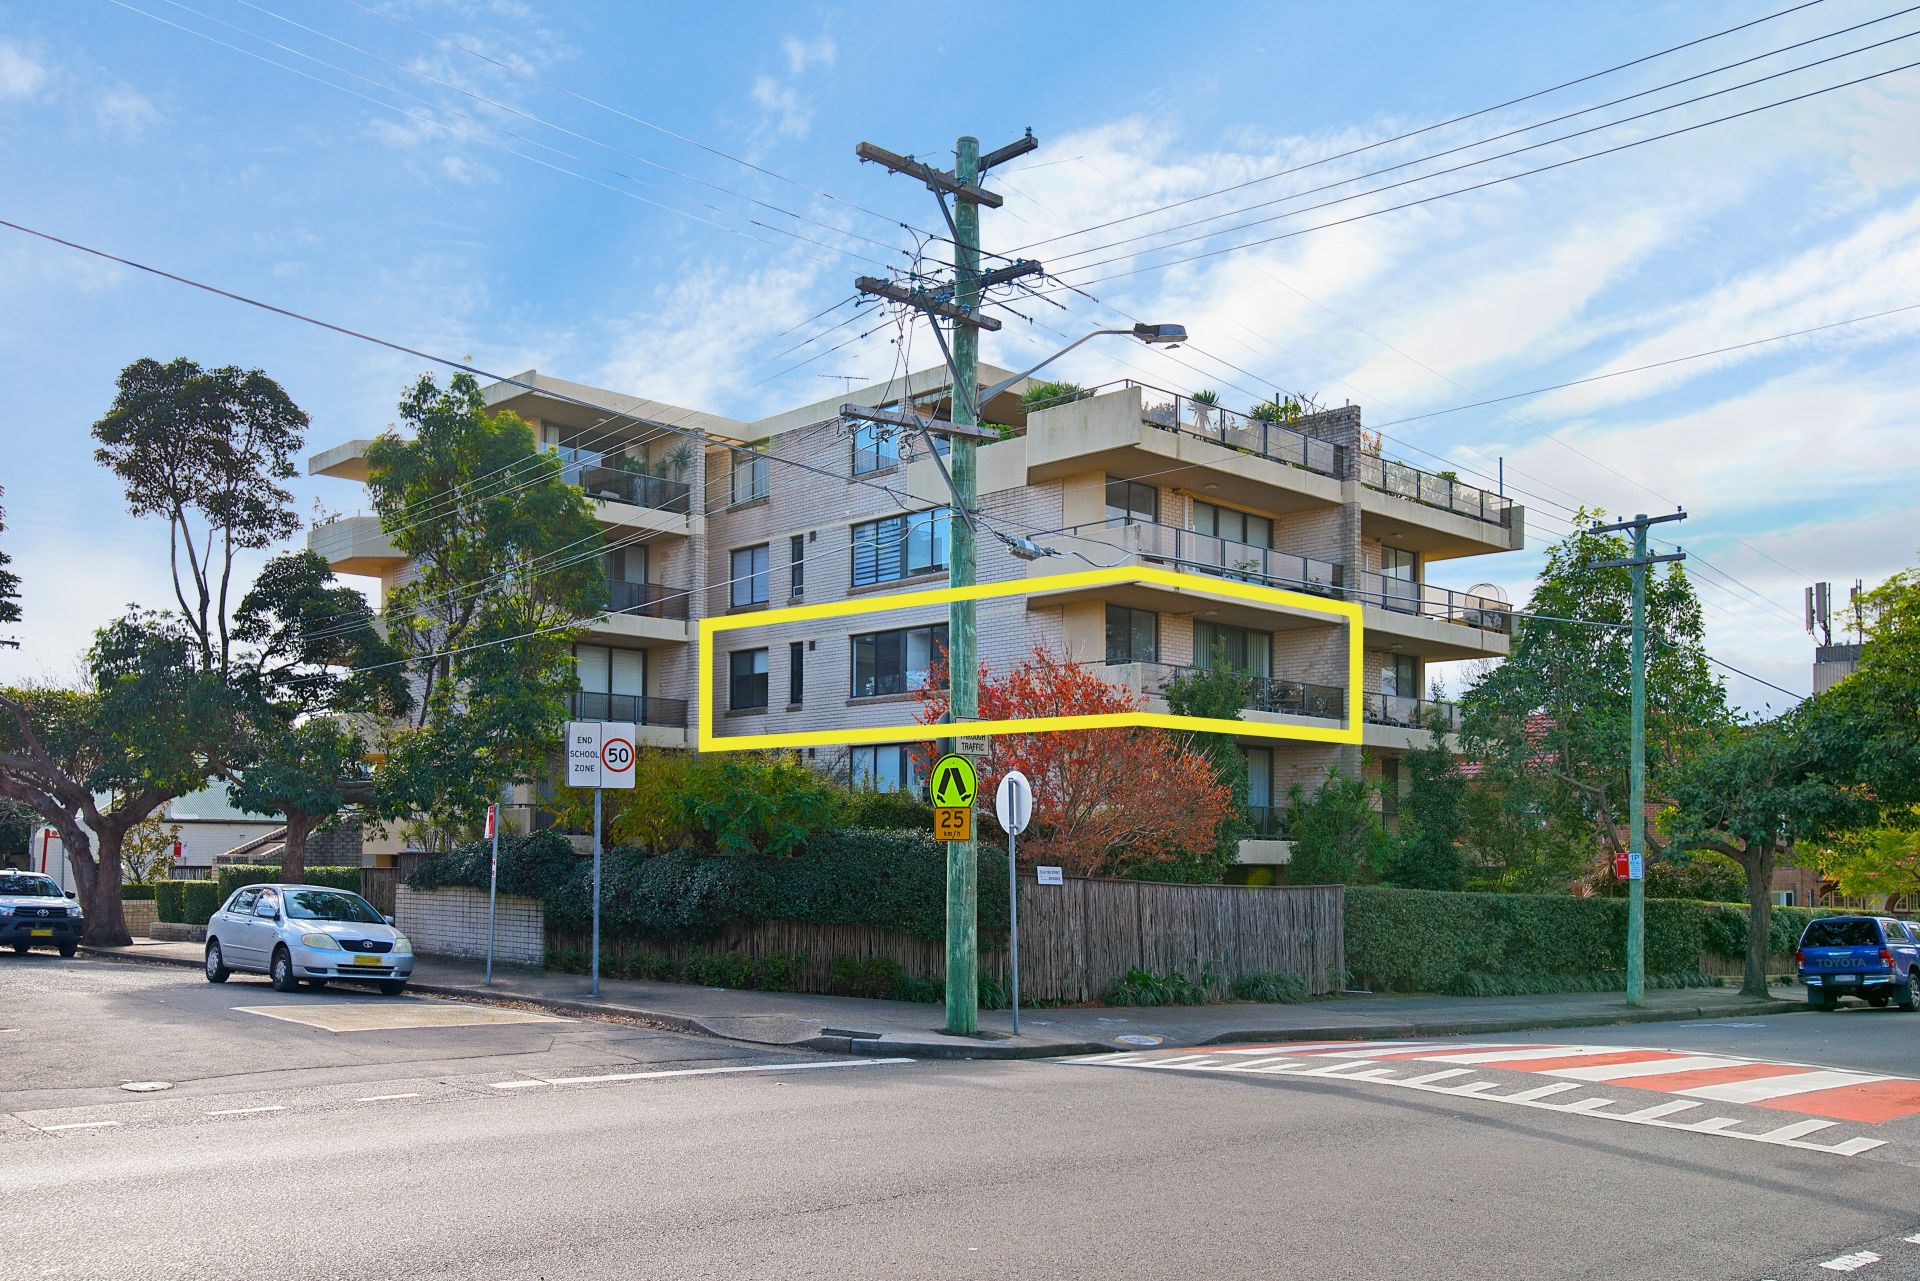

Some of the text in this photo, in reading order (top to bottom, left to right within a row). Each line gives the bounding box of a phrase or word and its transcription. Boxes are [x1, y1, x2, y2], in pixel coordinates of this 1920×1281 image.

[577, 736, 593, 744] END
[961, 743, 985, 752] TRAFFIC
[569, 750, 600, 759] SCHOOL
[608, 748, 629, 763] 50
[574, 765, 595, 773] ZONE
[941, 811, 964, 829] 25
[943, 830, 961, 838] km/h
[1816, 959, 1867, 968] TOYOTA
